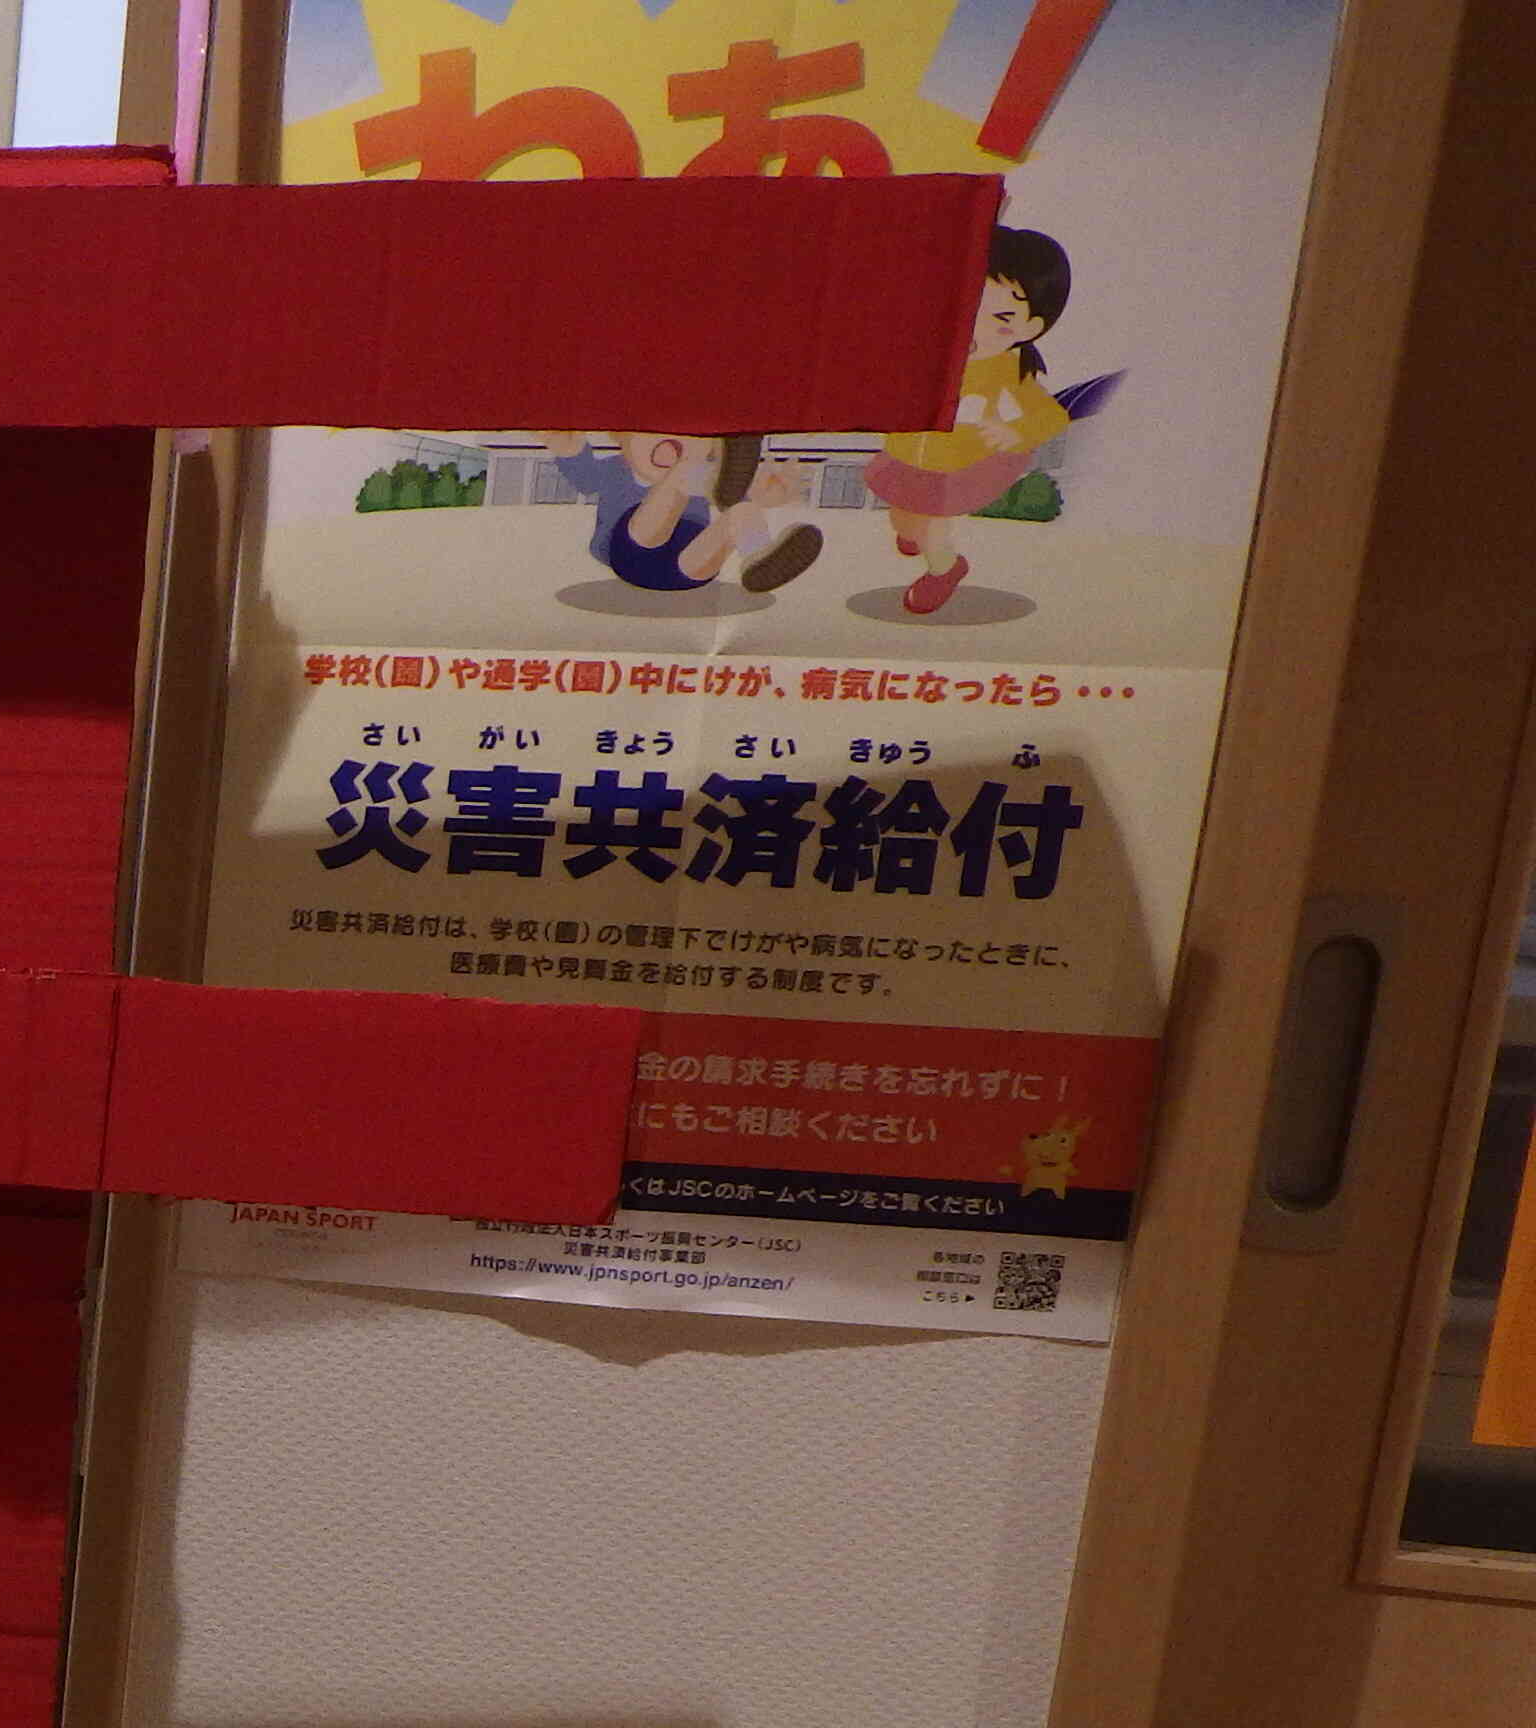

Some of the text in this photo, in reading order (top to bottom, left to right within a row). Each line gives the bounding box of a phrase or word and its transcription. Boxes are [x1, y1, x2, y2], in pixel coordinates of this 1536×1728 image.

[361, 722, 1041, 770] さい がい きょう さい きゅう ふ
[316, 760, 1084, 900] 災害共済給付
[623, 1176, 1005, 1216] くはJSCのホームページをご覧ください
[229, 1204, 378, 1231] JAPAN SPORT
[469, 1253, 795, 1291] https://www.jpnsport.go.jp/anzen/
